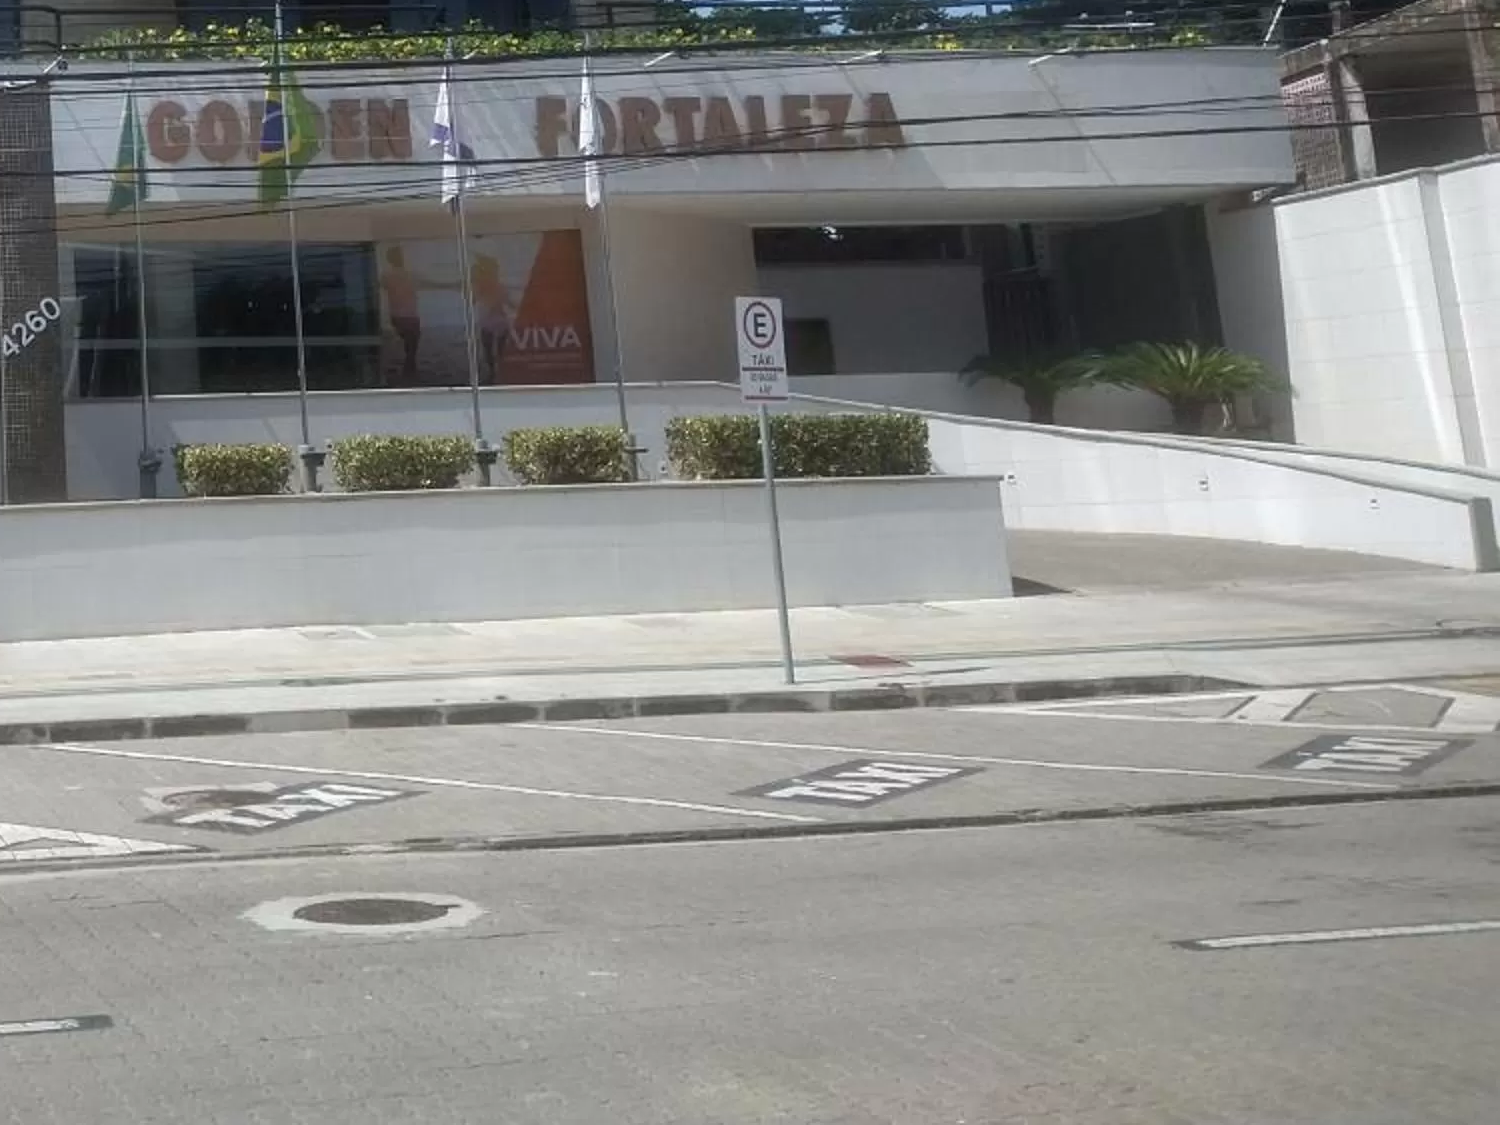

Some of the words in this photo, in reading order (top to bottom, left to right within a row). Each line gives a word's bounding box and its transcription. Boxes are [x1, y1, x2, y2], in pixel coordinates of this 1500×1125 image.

[147, 98, 413, 164] GOEN
[535, 92, 905, 158] FORTALEZA
[2, 297, 61, 357] 4260
[509, 325, 582, 350] VIVA
[753, 312, 767, 338] E
